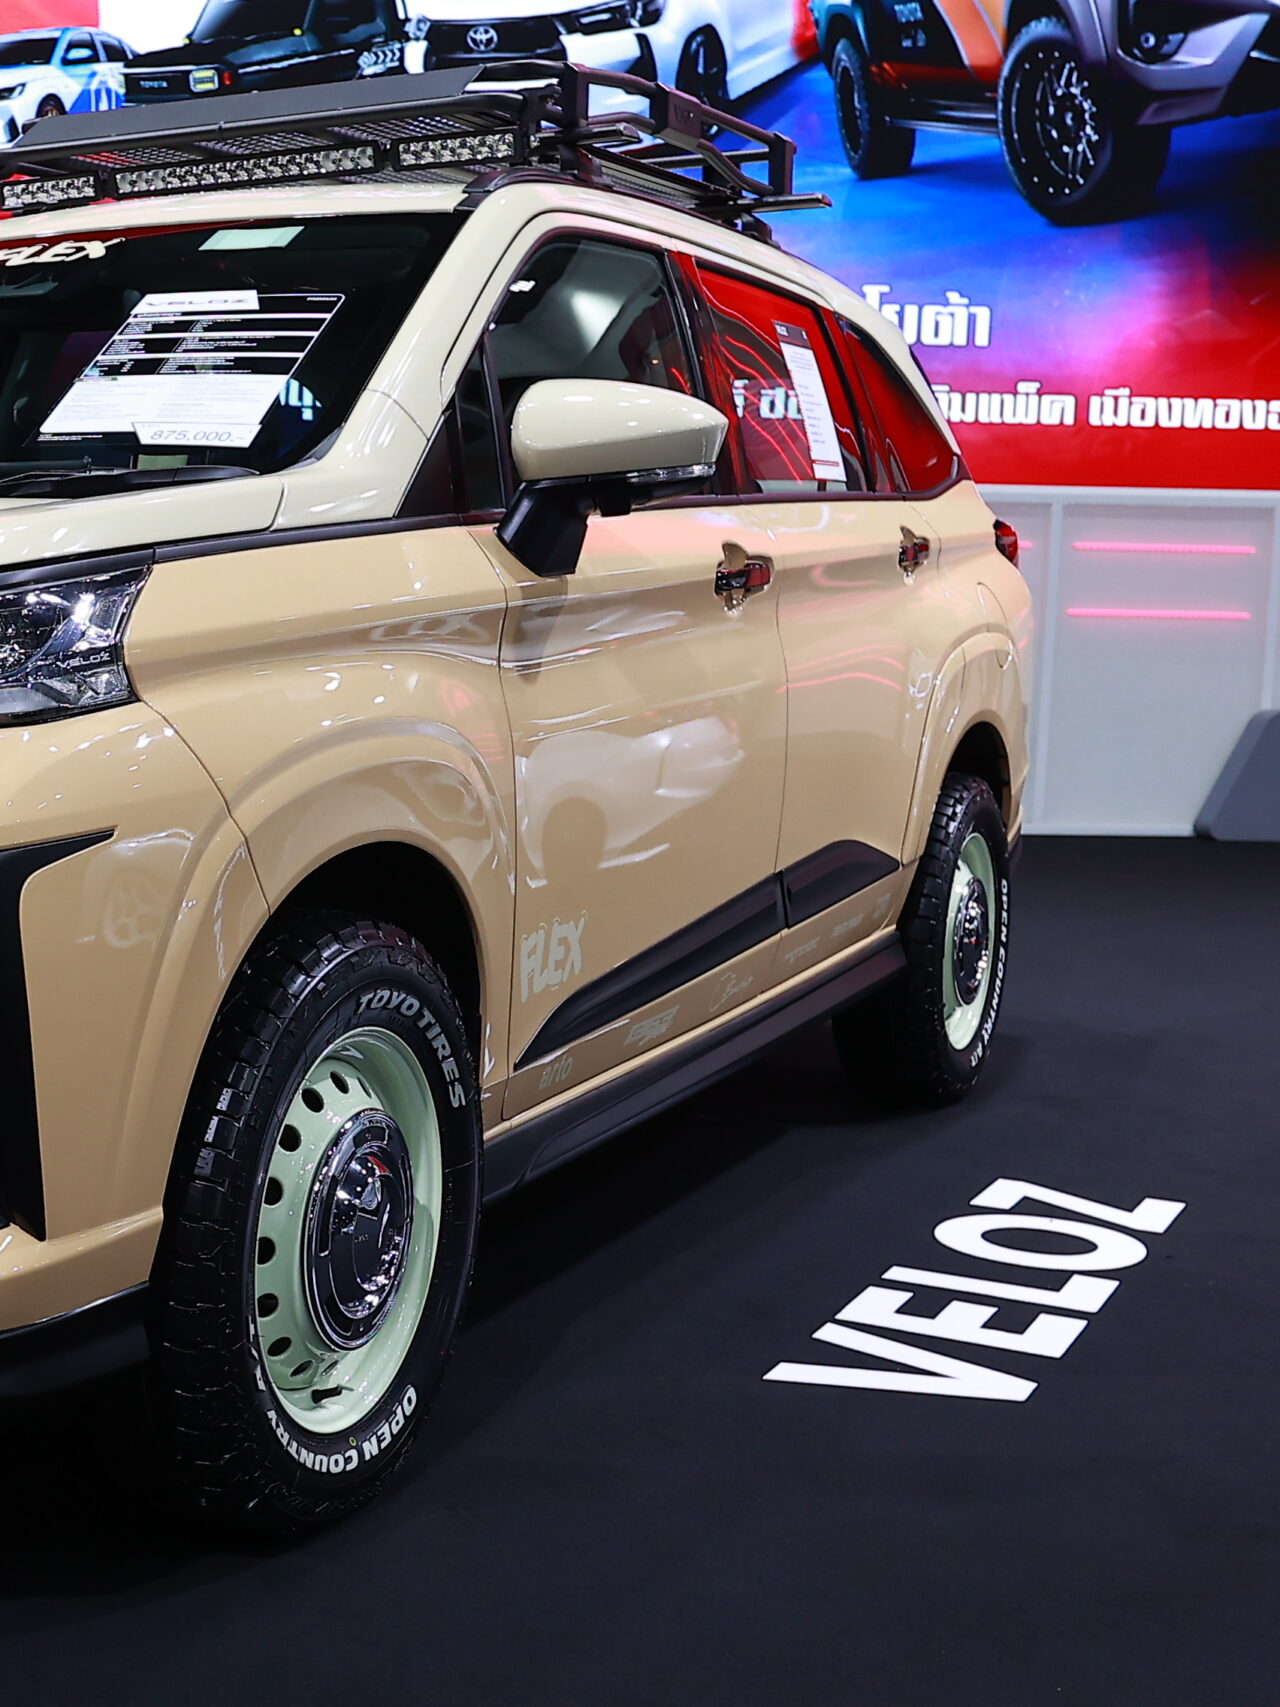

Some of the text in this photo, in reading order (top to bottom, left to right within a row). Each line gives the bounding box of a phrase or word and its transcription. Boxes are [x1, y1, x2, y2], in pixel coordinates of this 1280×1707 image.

[56, 651, 111, 668] VELOZ
[520, 910, 588, 1003] FLEX
[354, 989, 466, 1108] TOYO TIRES
[761, 1177, 1187, 1402] VELOZ
[267, 1409, 359, 1474] COUNTRY
[362, 1384, 417, 1461] OPEN
